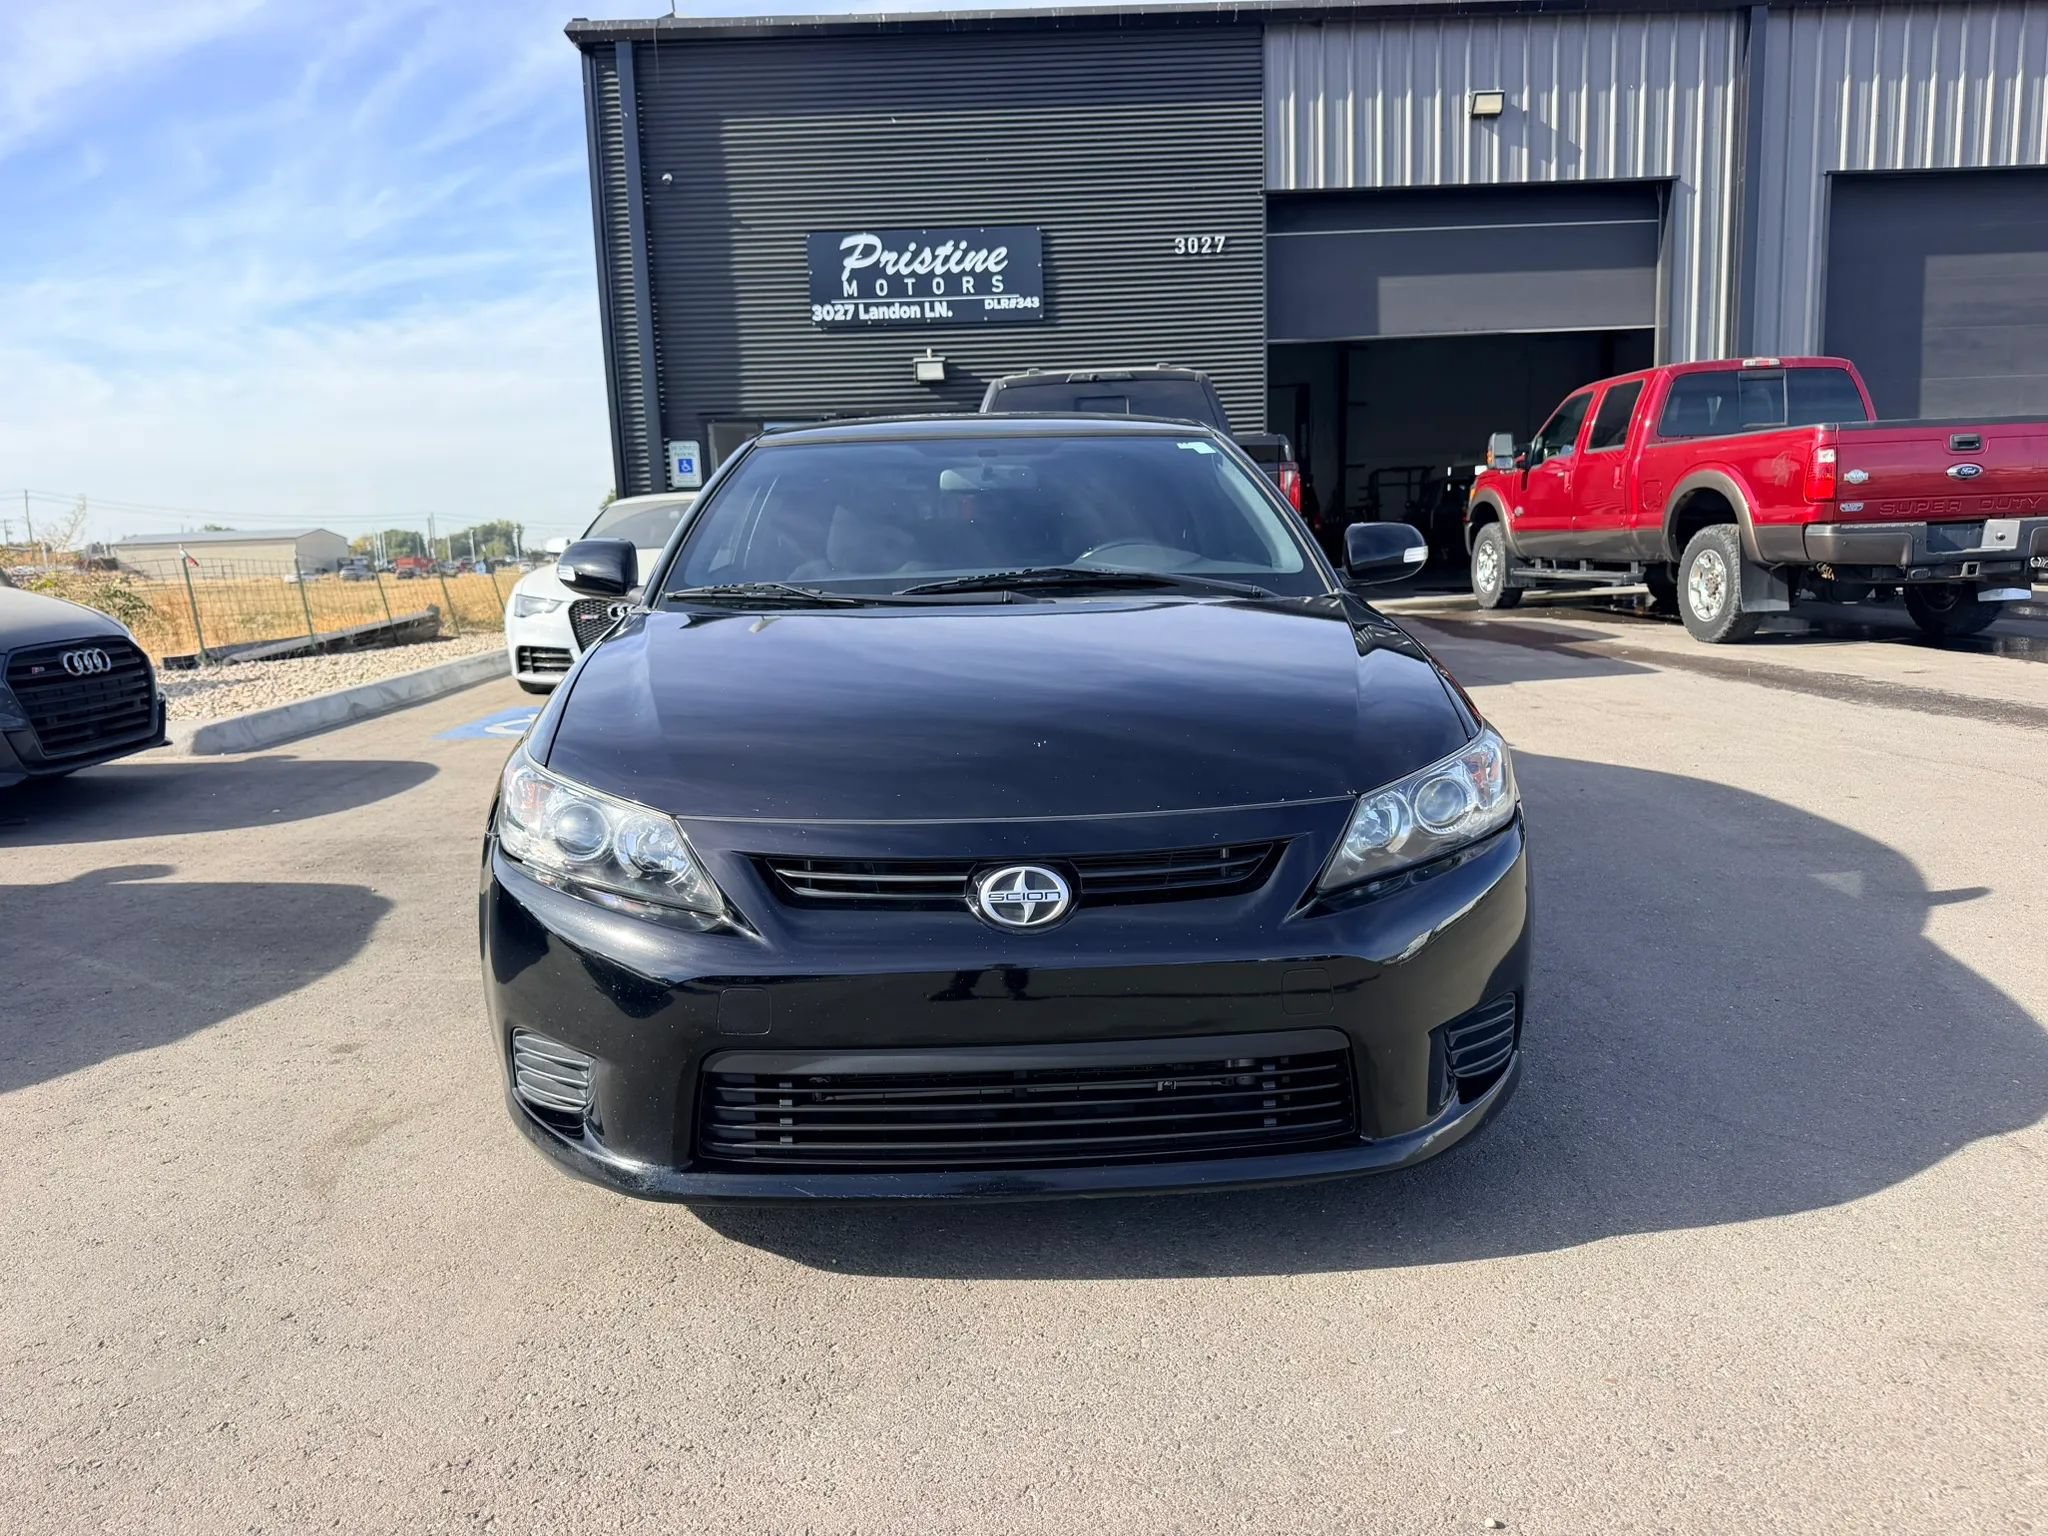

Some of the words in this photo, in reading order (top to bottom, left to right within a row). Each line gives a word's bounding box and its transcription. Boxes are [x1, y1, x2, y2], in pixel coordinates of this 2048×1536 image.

[1174, 235, 1226, 254] 3027
[839, 233, 1009, 281] Pristine
[842, 275, 1004, 297] MOTORS
[811, 304, 855, 321] 3027
[858, 302, 921, 320] Landon
[924, 301, 953, 318] LN.
[1879, 500, 1962, 515] SUPER
[1977, 496, 2042, 511] DUTY
[988, 891, 1061, 902] SCION
